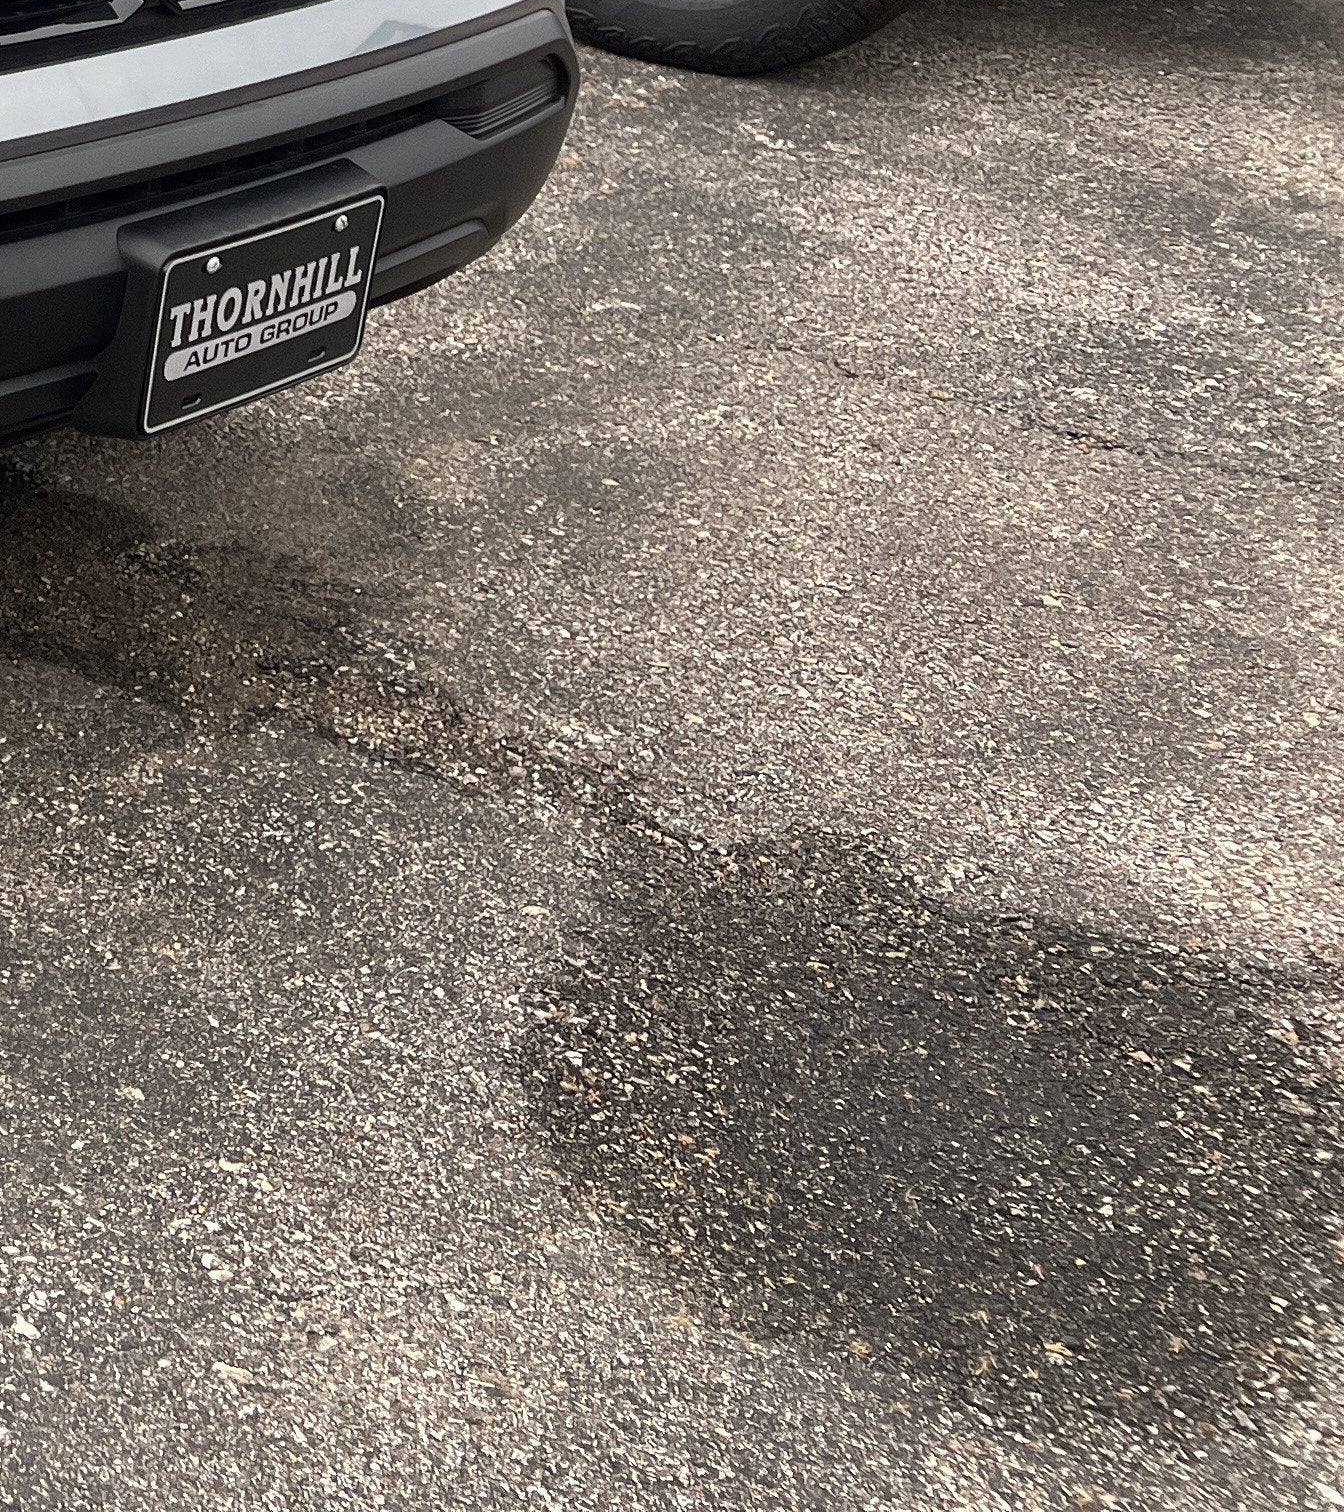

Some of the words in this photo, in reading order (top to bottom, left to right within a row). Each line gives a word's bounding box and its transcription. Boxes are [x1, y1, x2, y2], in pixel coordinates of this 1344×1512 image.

[169, 245, 363, 348] THORNHILL
[182, 332, 253, 372] AUTO
[259, 300, 339, 345] GROUP
